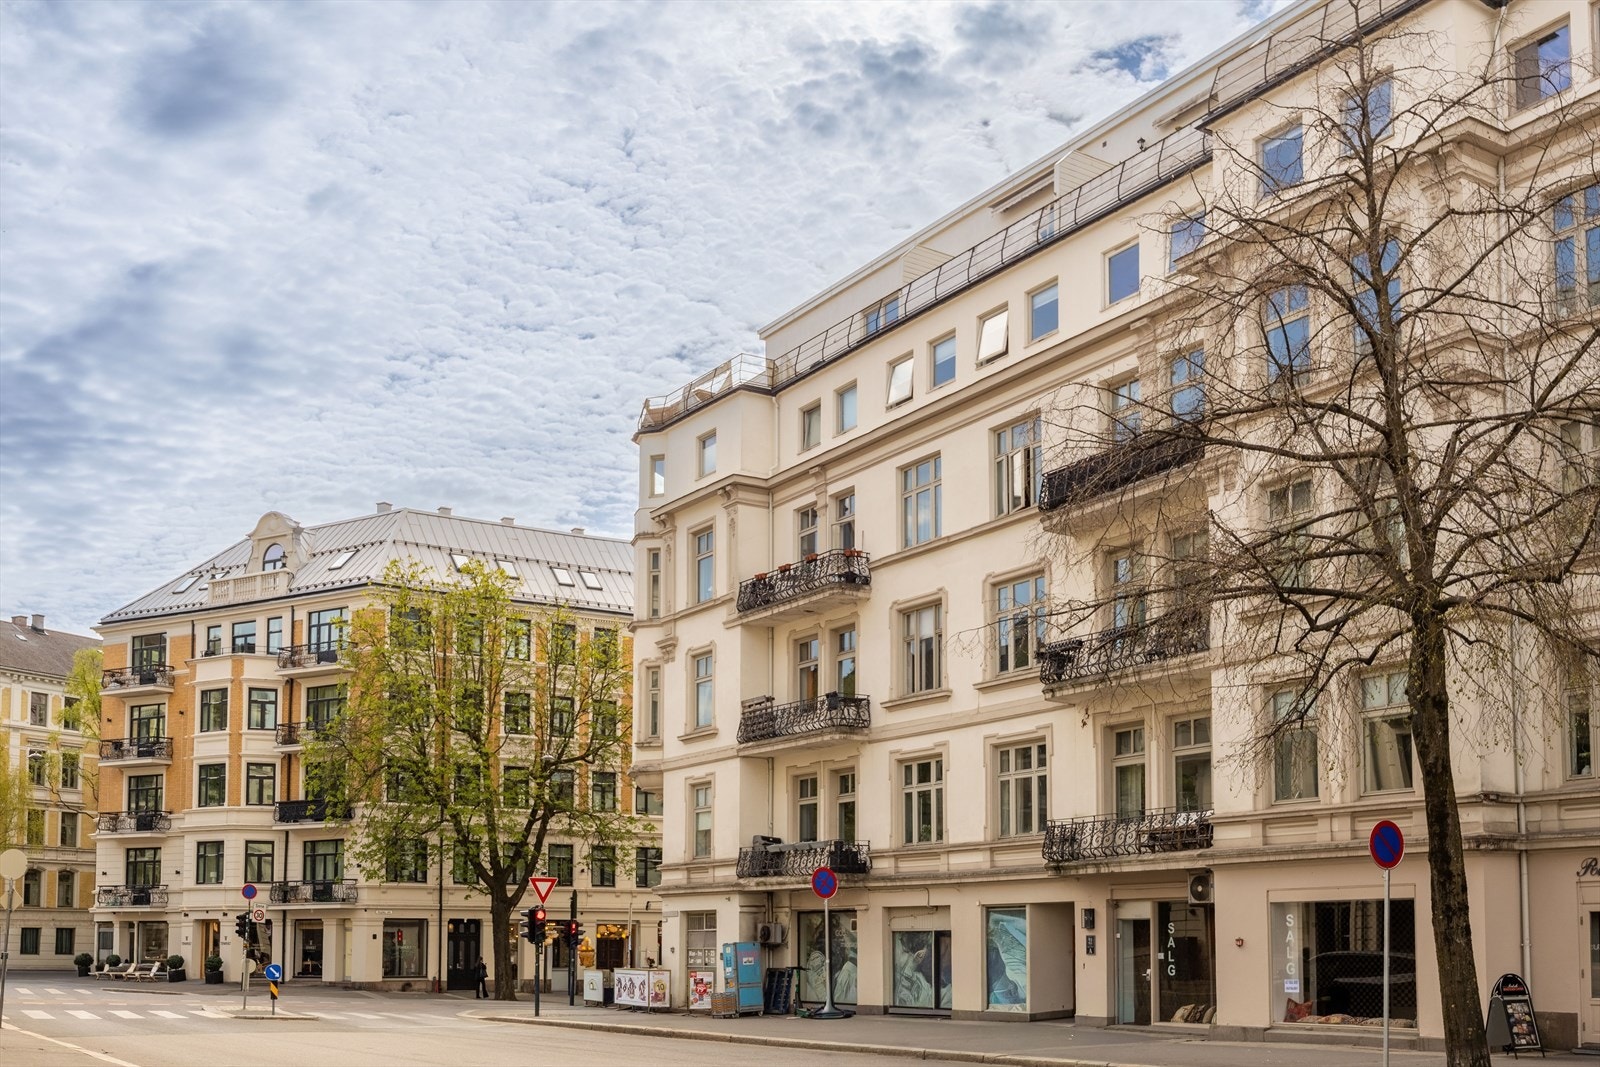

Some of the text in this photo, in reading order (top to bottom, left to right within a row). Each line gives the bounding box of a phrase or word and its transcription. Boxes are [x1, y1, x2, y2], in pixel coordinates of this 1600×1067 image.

[1167, 922, 1176, 976] SALG
[1286, 914, 1295, 975] SALG
[656, 983, 665, 991] 10
